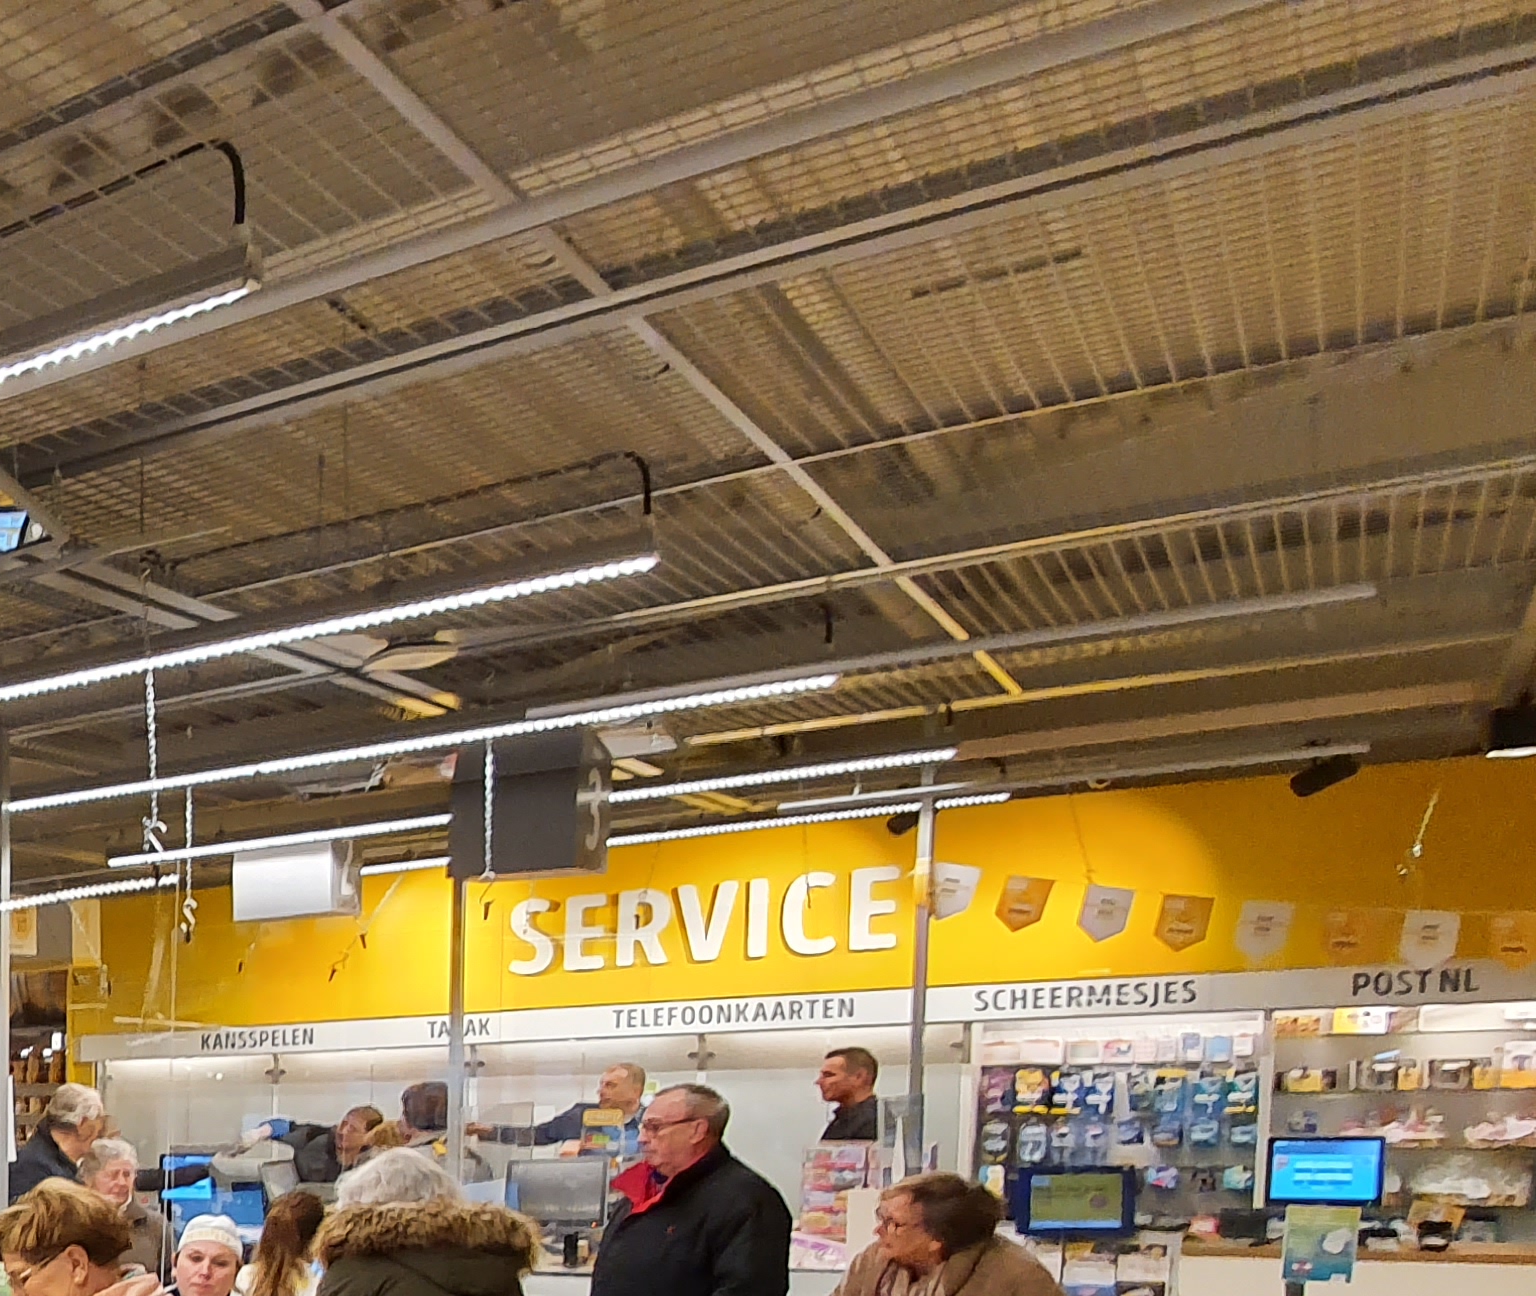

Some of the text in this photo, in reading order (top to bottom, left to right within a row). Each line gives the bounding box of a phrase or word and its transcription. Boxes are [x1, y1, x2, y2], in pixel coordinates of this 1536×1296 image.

[509, 866, 900, 976] SERVICE
[974, 980, 1197, 1011] SCHEERMESJES
[1352, 969, 1480, 996] POST NL
[612, 998, 855, 1029] TELEFOONKAARTEN
[201, 1018, 490, 1050] KANSSPELEN TAAK
